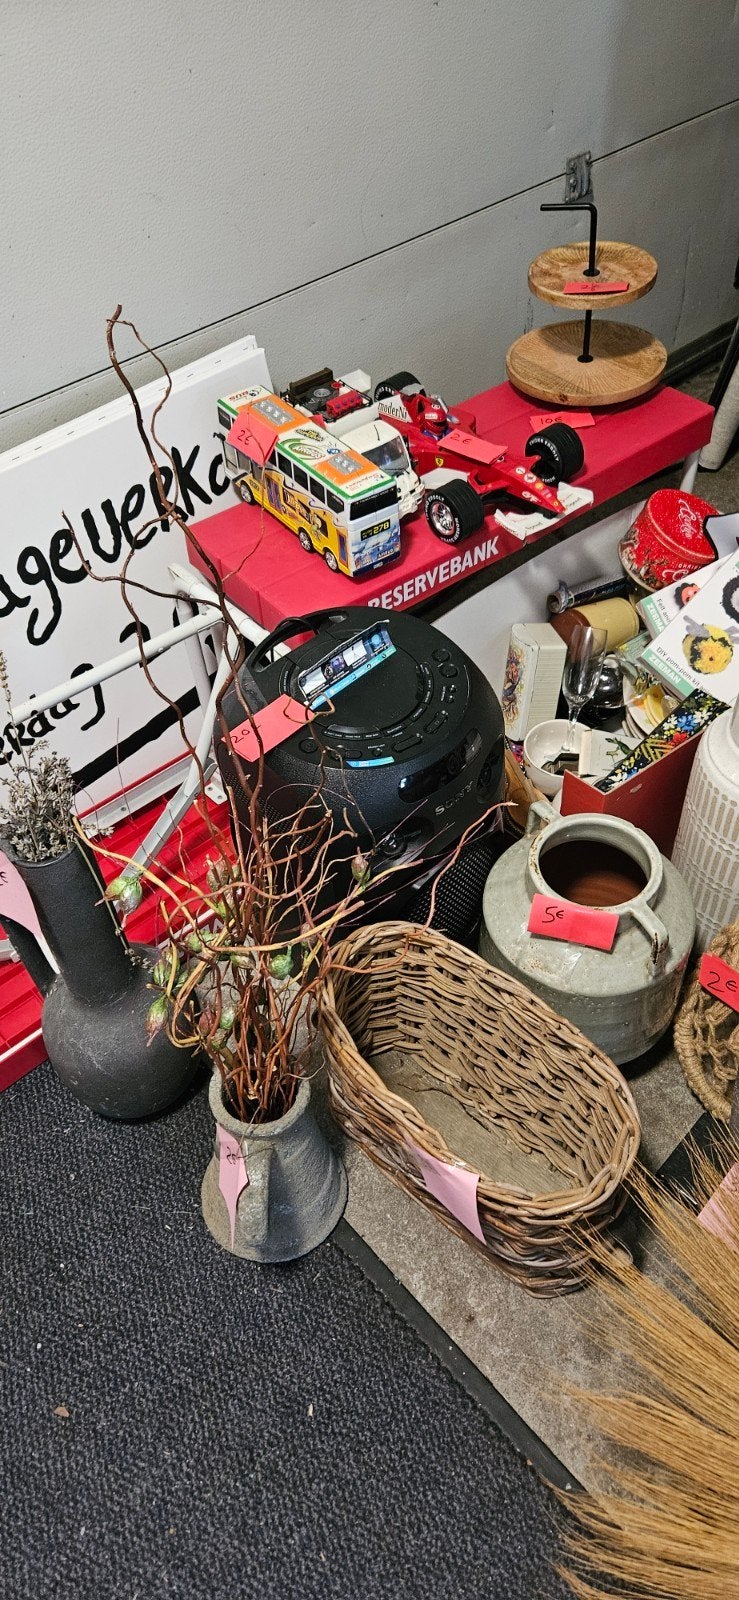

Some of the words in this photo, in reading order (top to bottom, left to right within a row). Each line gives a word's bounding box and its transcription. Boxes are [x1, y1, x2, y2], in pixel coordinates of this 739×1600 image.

[647, 603, 666, 633] ZEEMA
[648, 653, 683, 685] ZEEMAN
[541, 905, 565, 924] 5€
[706, 971, 739, 994] 2€
